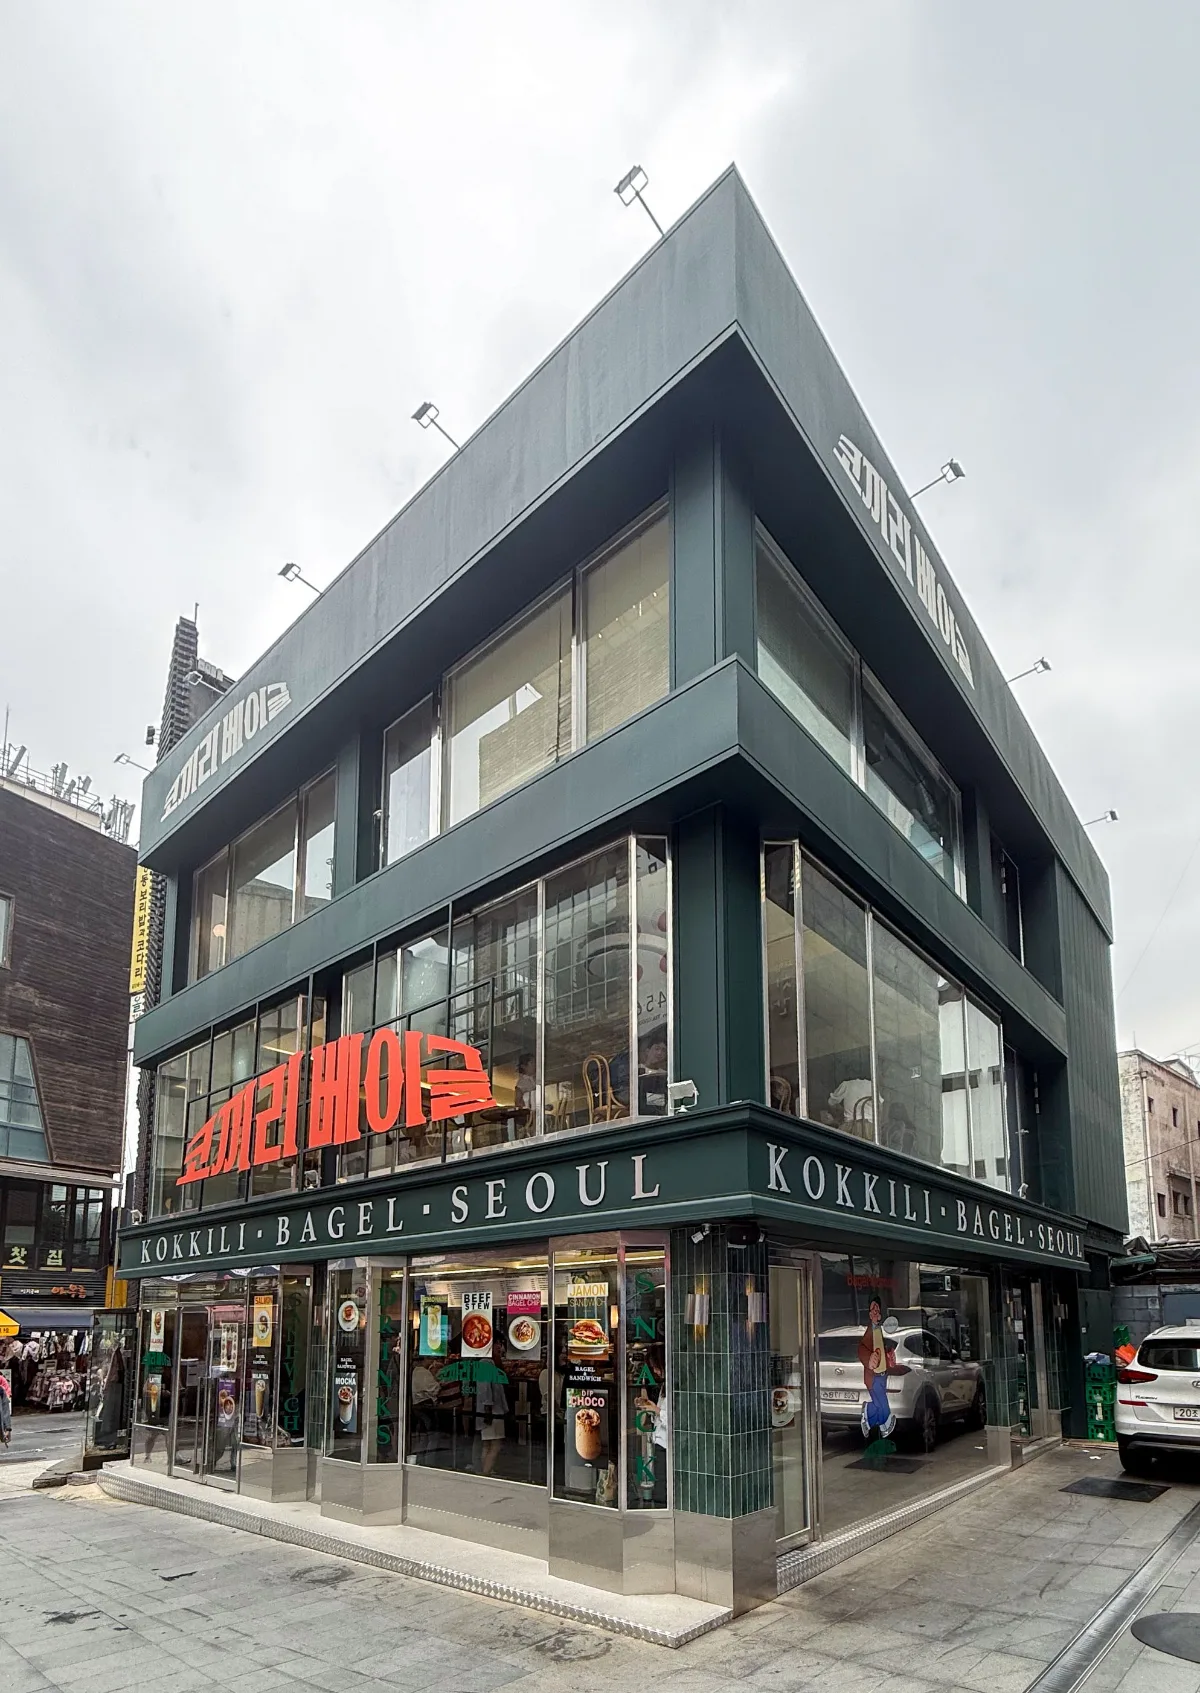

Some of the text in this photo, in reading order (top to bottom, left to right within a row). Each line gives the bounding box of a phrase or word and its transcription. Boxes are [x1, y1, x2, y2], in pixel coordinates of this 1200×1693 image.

[134, 940, 145, 979] 코다리
[176, 1027, 498, 1186] 코끼리 베이글
[765, 1142, 1083, 1259] KOKKILI BAGEL SEOUL
[140, 1154, 660, 1265] KOKKILI BAGEL SEOUL
[569, 1284, 607, 1297] JAMON
[464, 1292, 491, 1303] BEEF
[464, 1302, 490, 1311] STEW
[376, 1287, 397, 1445] DRINKS
[335, 1377, 357, 1386] MOCHA
[634, 1272, 658, 1482] SNACK
[581, 1389, 594, 1397] DIP
[571, 1396, 605, 1408] CHOCO
[1179, 1408, 1199, 1418] 20조
